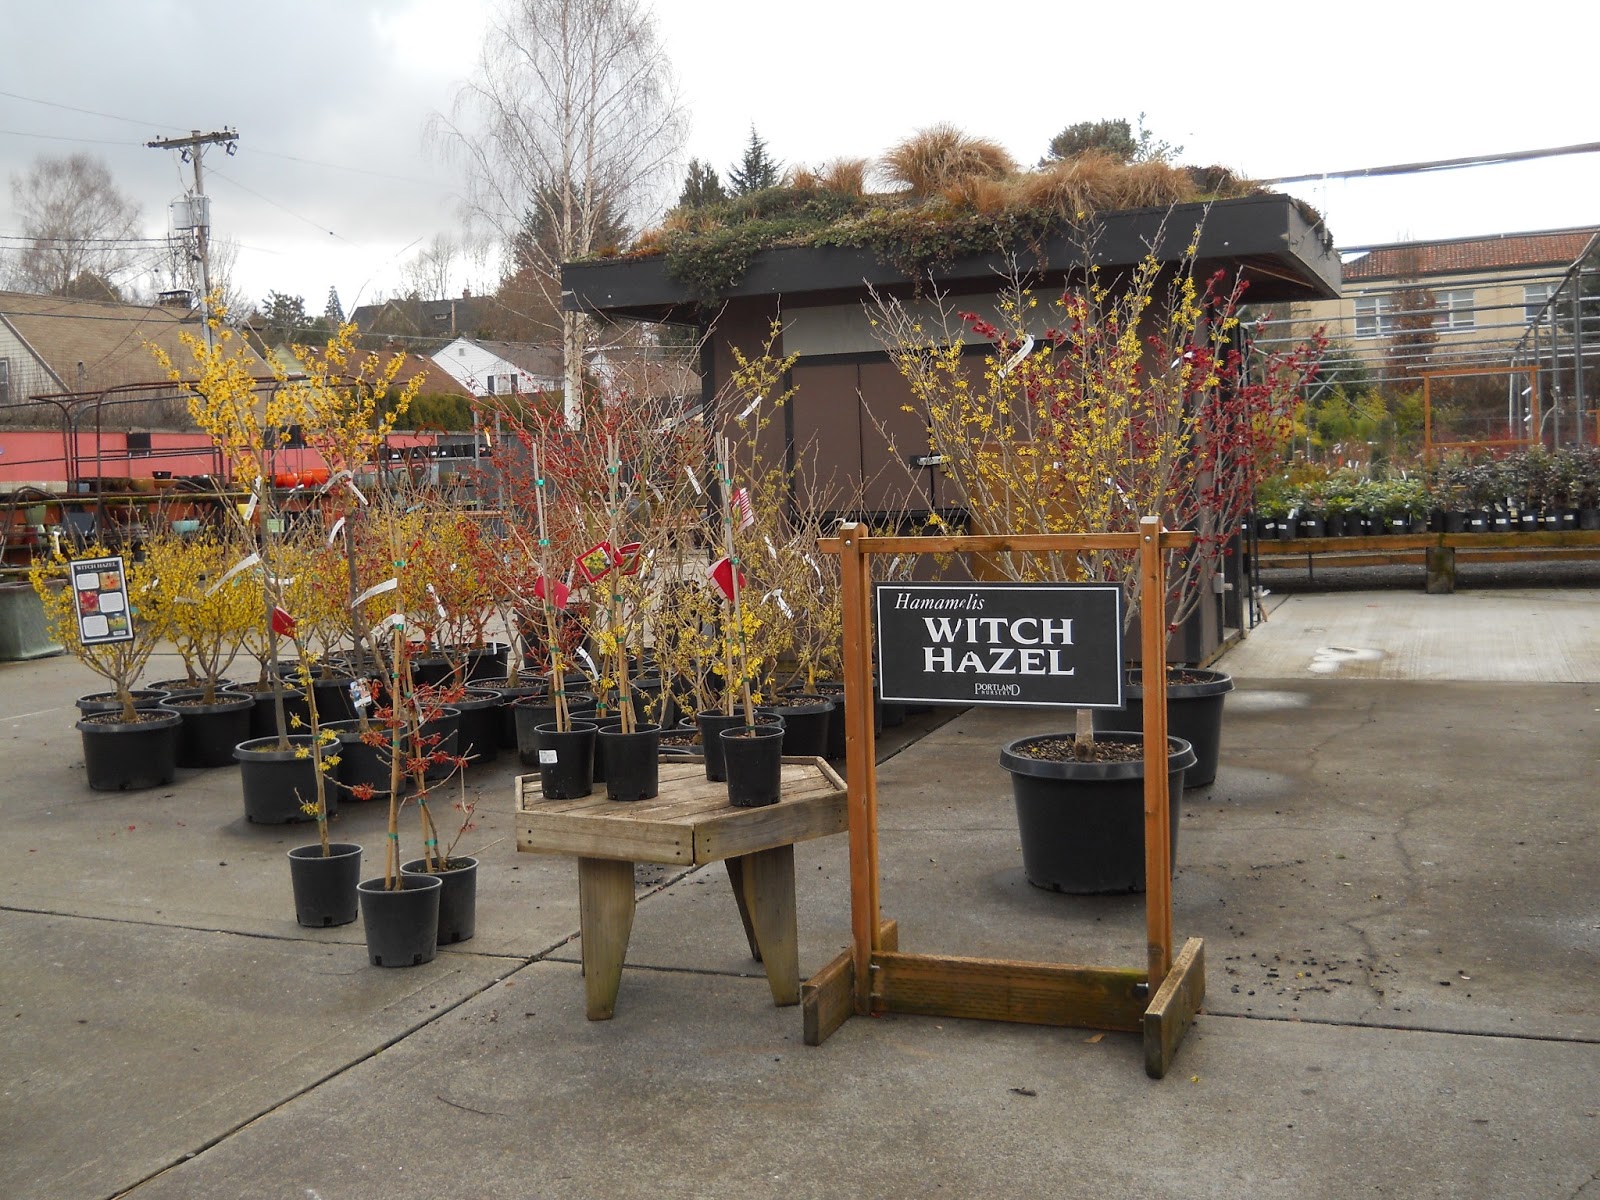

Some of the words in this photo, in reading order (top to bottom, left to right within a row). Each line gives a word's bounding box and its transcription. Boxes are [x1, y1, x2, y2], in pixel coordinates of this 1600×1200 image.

[894, 593, 985, 610] Hamamelis
[922, 617, 1074, 645] WITCH
[922, 647, 1074, 676] HAZEL
[974, 682, 1020, 696] PORTLAND
